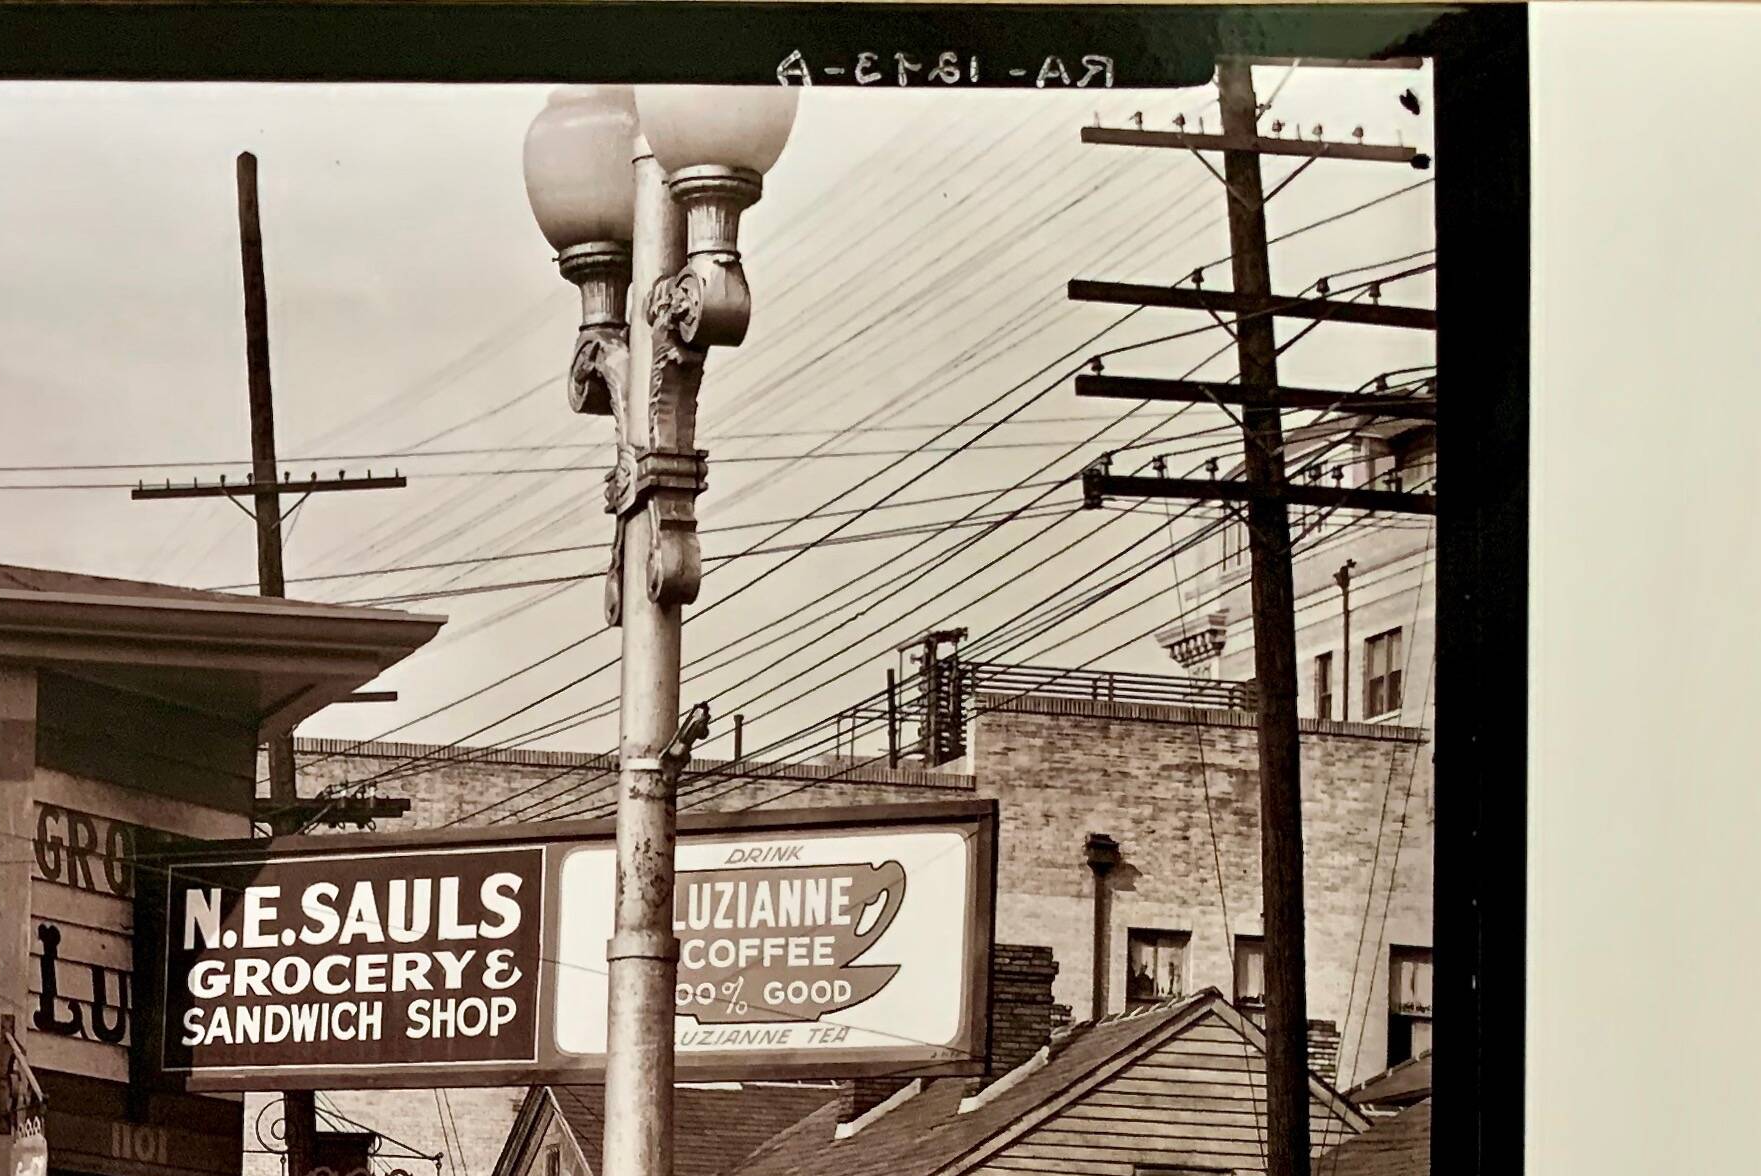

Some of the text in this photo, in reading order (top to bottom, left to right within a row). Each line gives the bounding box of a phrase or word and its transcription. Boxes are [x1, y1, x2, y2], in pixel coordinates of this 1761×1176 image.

[724, 845, 803, 865] DRINK
[674, 875, 854, 931] UZIANNE
[682, 935, 836, 969] COFFEE
[187, 948, 523, 1000] GROCERY &
[762, 979, 852, 1004] GOOD
[181, 996, 518, 1047] SANDWICH SHOP
[674, 1025, 852, 1047] UZIANNE TEA
